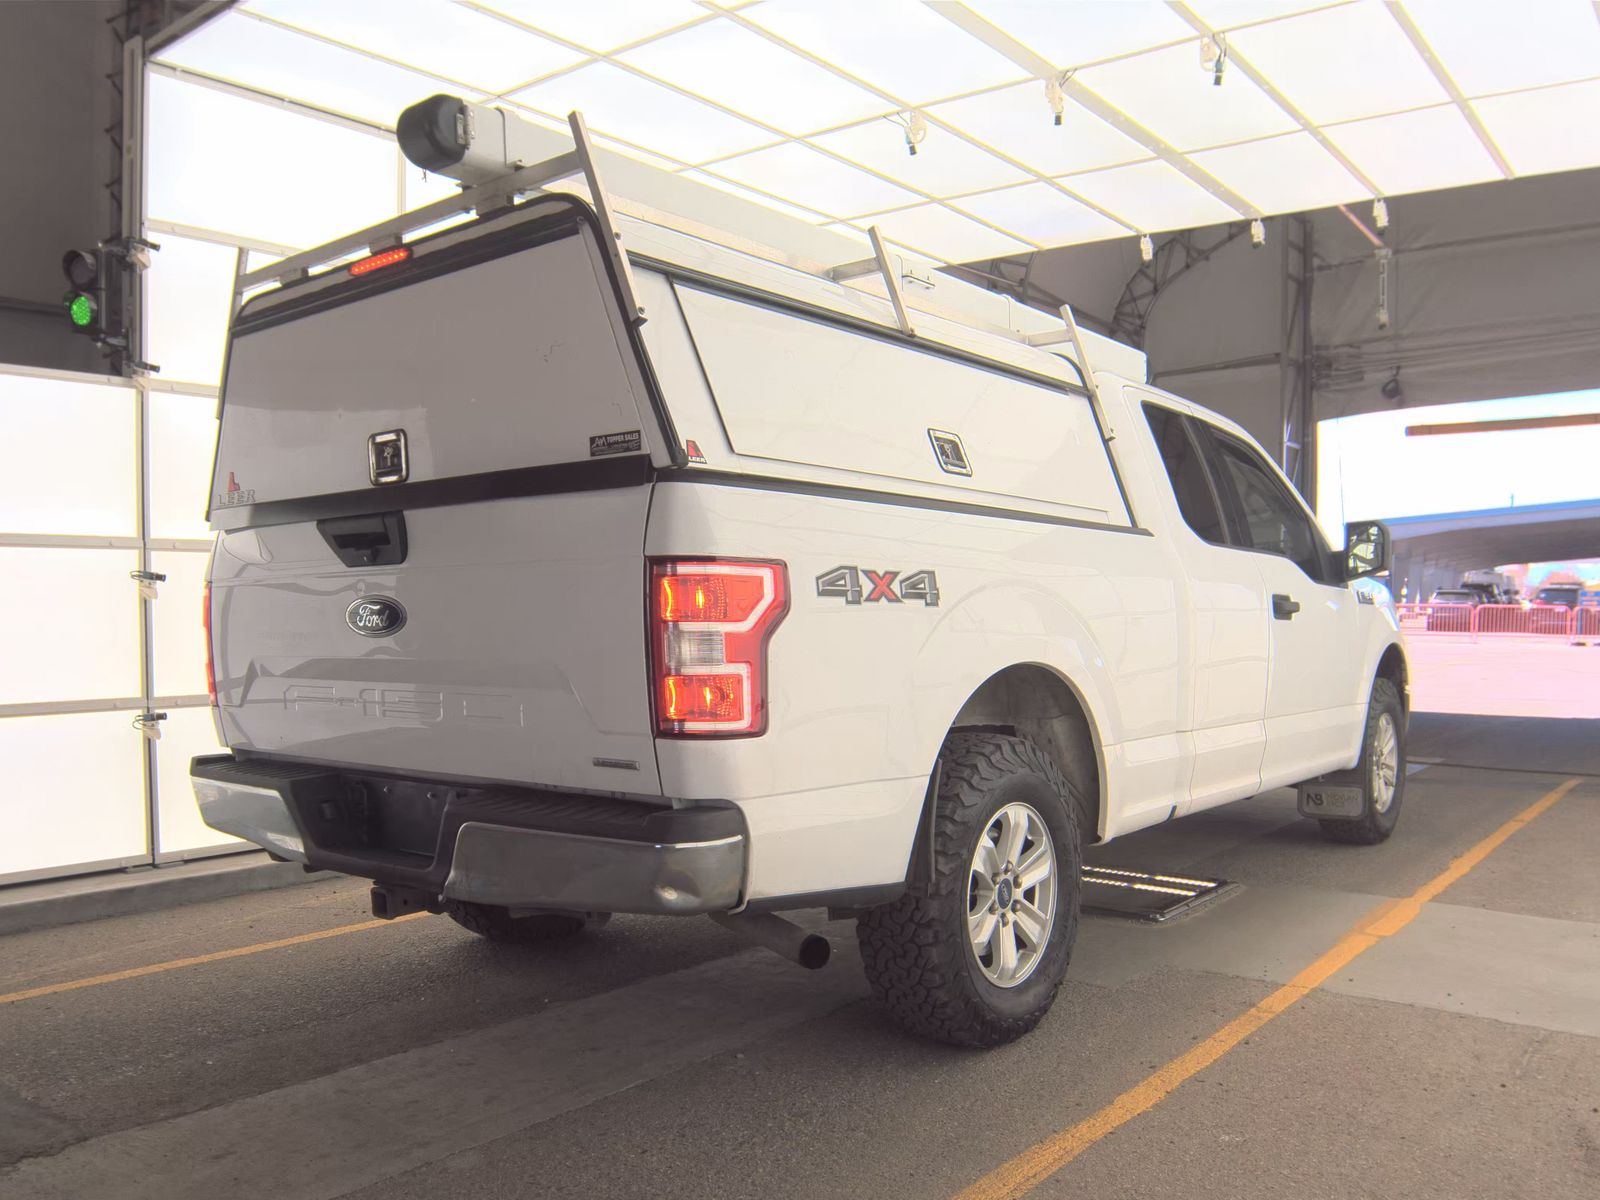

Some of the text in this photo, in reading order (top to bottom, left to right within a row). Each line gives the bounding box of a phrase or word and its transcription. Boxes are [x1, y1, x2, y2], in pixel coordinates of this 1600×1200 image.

[607, 434, 624, 444] TOPPER
[625, 432, 639, 441] SALES
[218, 489, 256, 506] LEER
[356, 603, 389, 628] Ford
